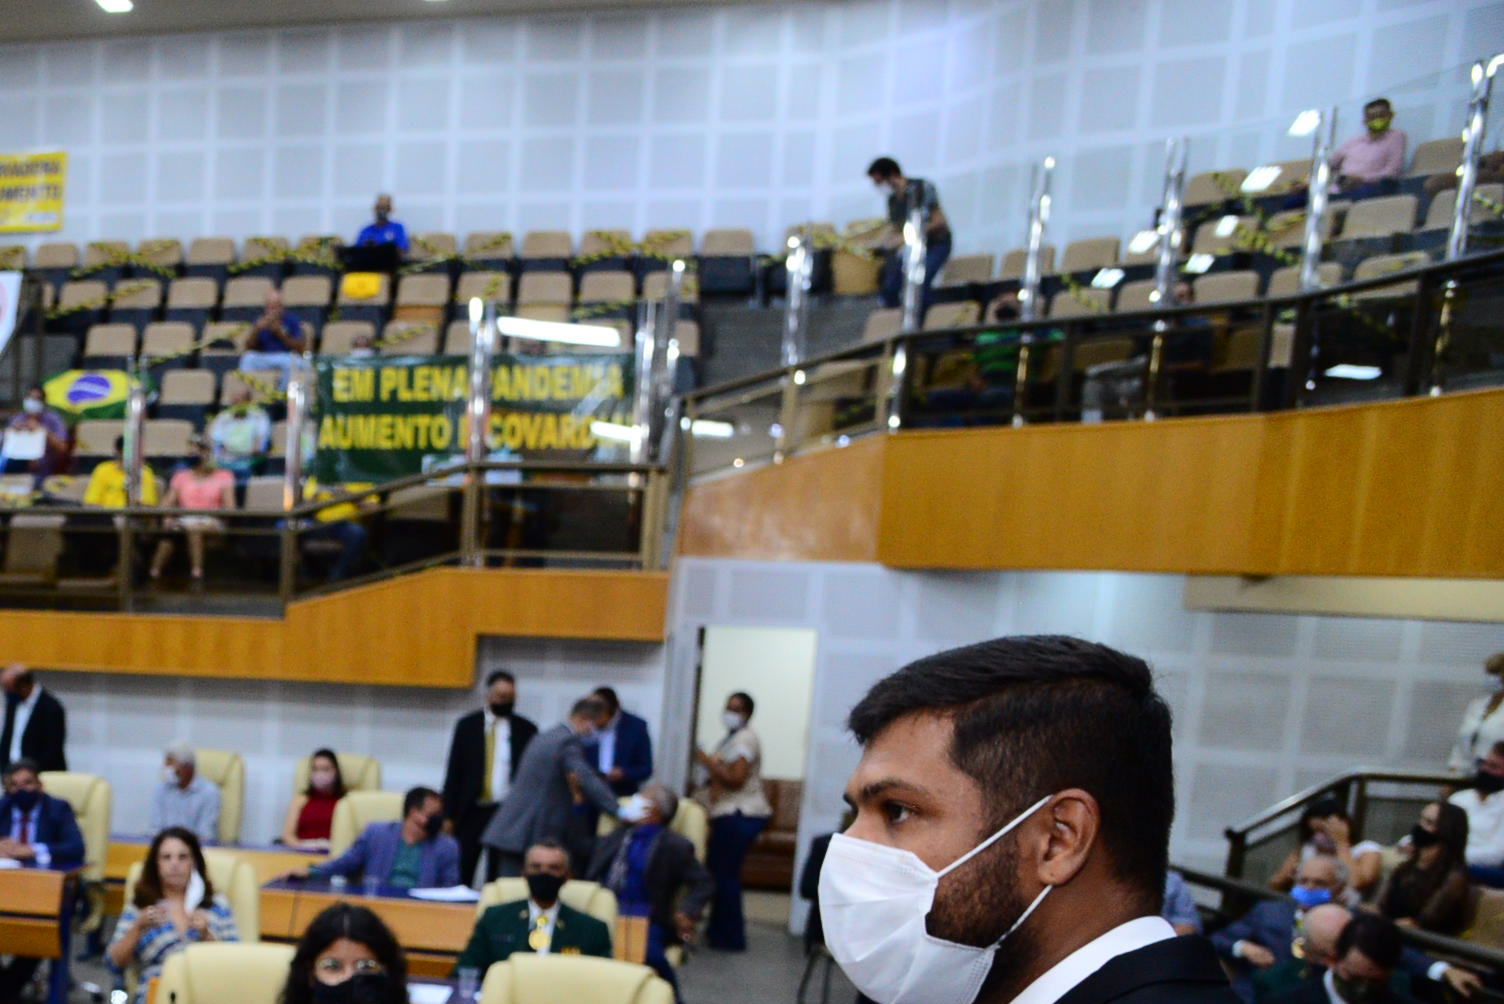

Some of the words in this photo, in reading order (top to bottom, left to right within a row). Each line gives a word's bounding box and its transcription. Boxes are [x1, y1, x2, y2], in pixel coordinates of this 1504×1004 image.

[333, 367, 375, 402] EM
[380, 364, 470, 402] PLENA
[488, 363, 625, 401] ANDEMA
[319, 413, 453, 450] AUMENTO
[484, 412, 634, 450] COVARD
